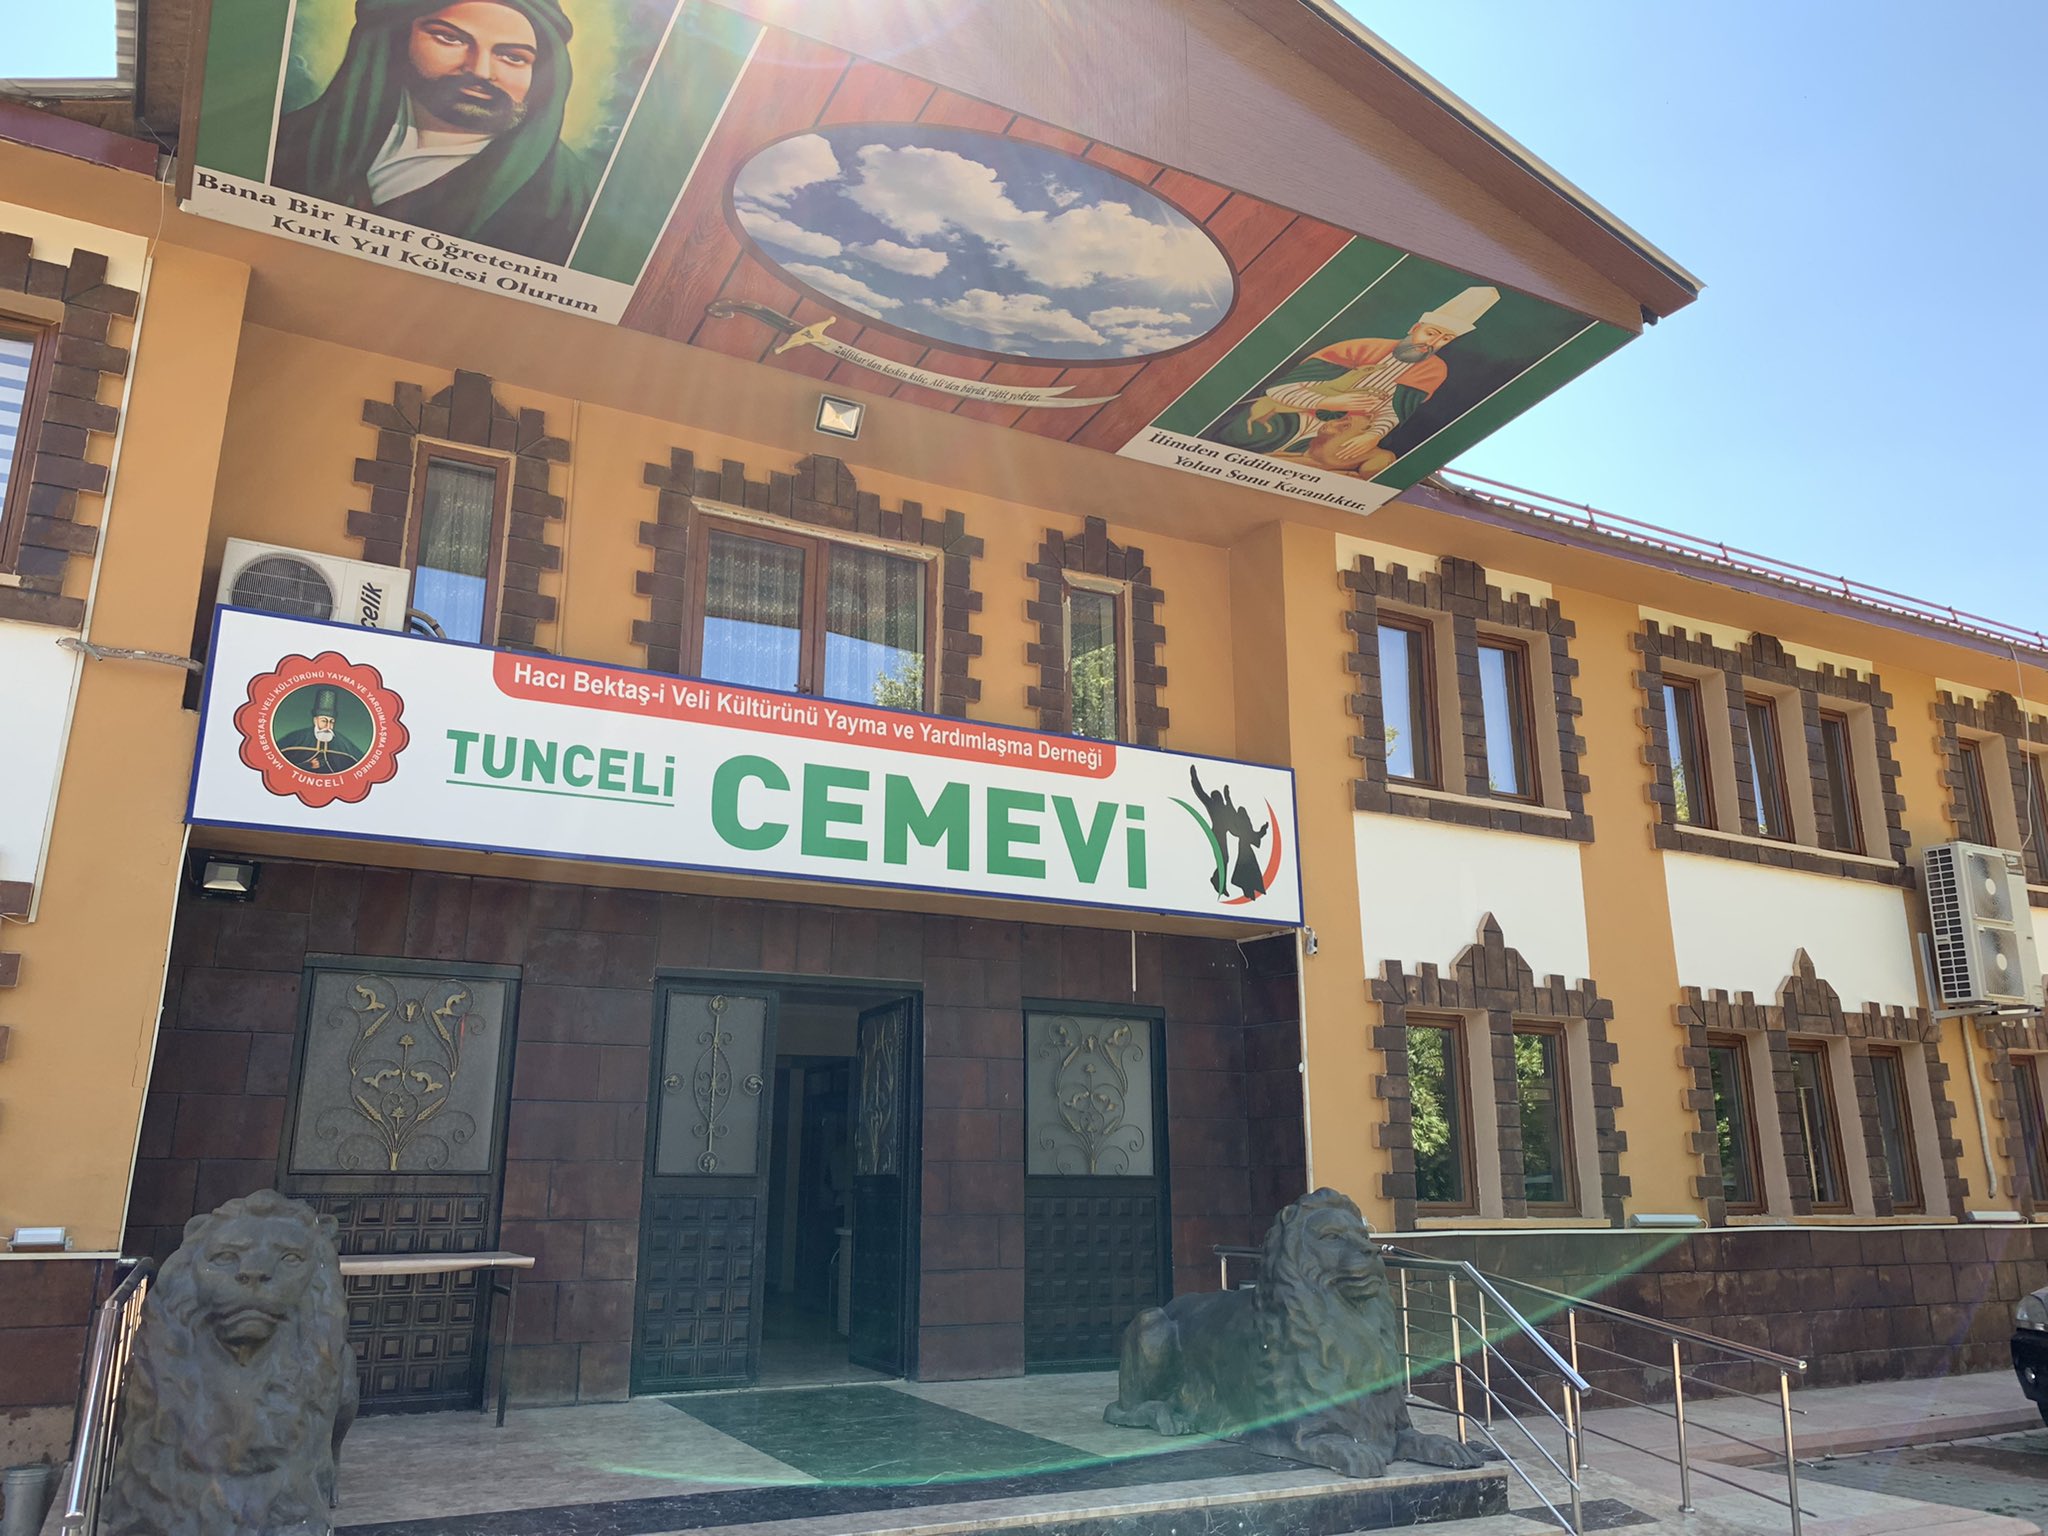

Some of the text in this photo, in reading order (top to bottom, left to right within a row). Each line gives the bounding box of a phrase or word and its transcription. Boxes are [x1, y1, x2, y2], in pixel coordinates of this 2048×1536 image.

[197, 172, 558, 283] Bana Bir Harf Öğretenin
[272, 215, 599, 313] Kırk Yıl Kölesi Olurum
[882, 363, 909, 380] keskin
[1149, 431, 1321, 484] İlimden Gidilmeyen
[1174, 455, 1366, 511] Yolun Sonu Karanlıktır.
[265, 751, 284, 770] HACI
[327, 672, 355, 686] YAYMA
[357, 683, 368, 694] VE
[513, 662, 1102, 770] Hacı Bektaş-i Veli Kültürünü Yayma ve Yardımlaşma Derneği
